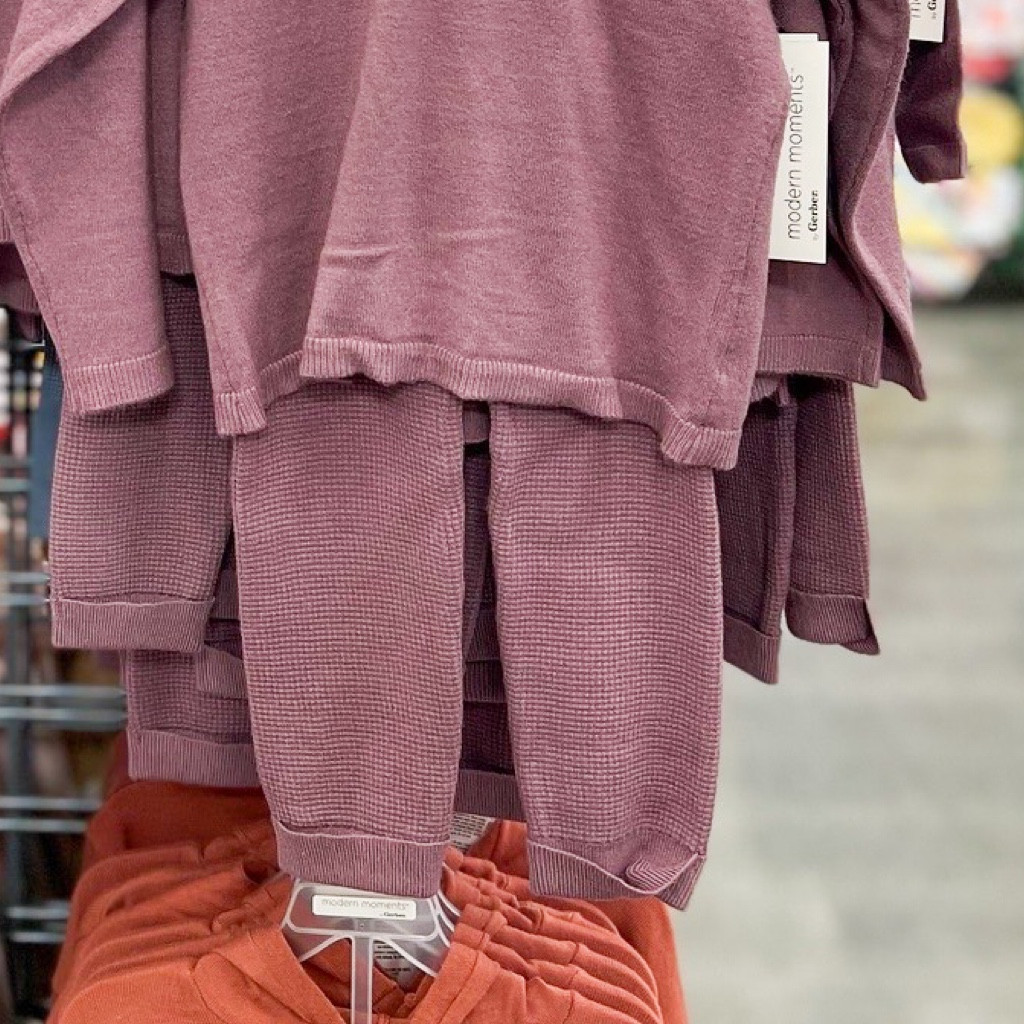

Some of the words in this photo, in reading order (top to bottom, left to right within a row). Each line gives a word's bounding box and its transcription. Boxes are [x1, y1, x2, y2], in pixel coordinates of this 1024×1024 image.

[784, 171, 802, 240] modern
[807, 189, 819, 233] Gerber
[321, 898, 359, 908] modern
